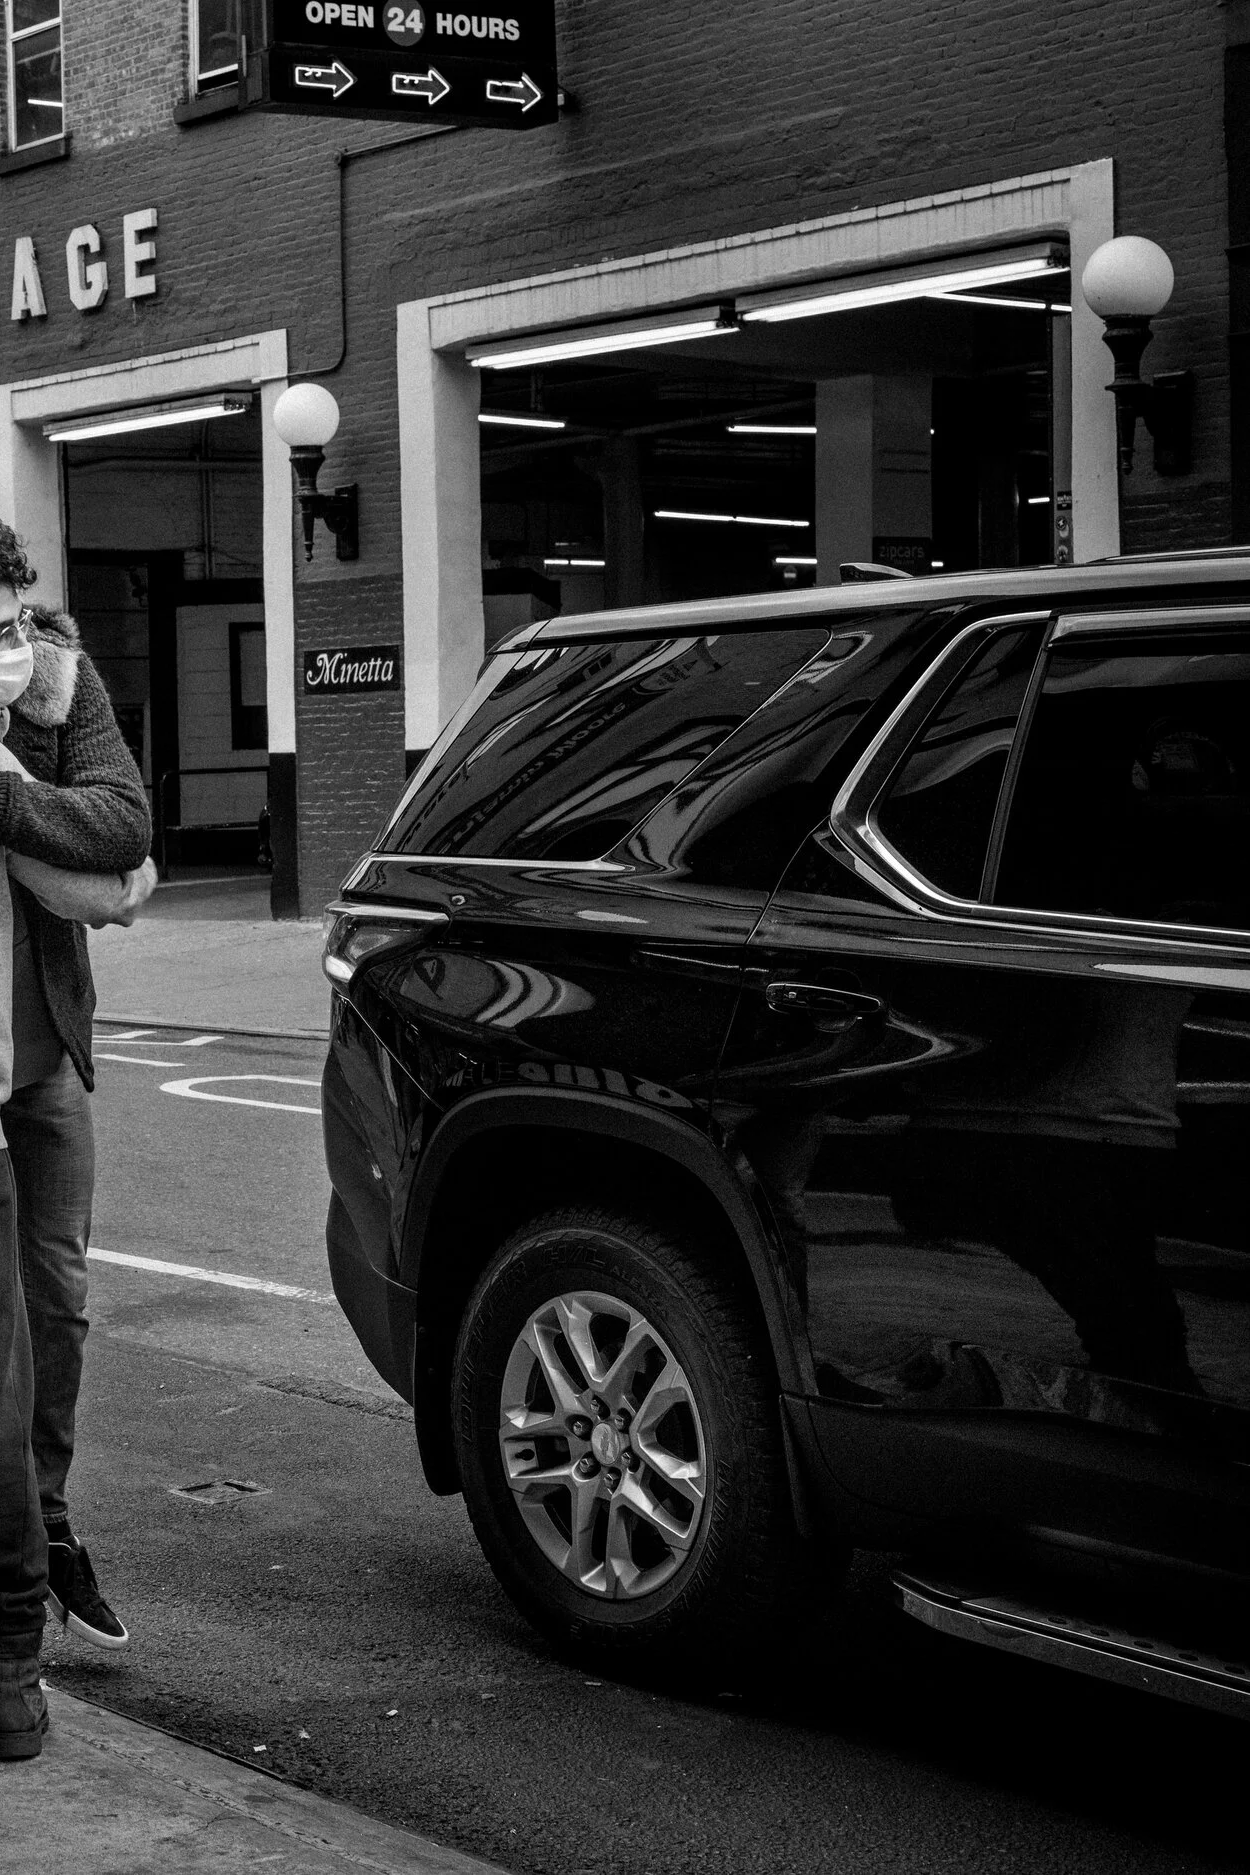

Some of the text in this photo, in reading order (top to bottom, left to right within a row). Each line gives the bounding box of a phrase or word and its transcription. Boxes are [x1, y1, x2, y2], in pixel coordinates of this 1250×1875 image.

[305, 2, 520, 41] OPEN 24 HOURS
[306, 652, 394, 686] Minetta
